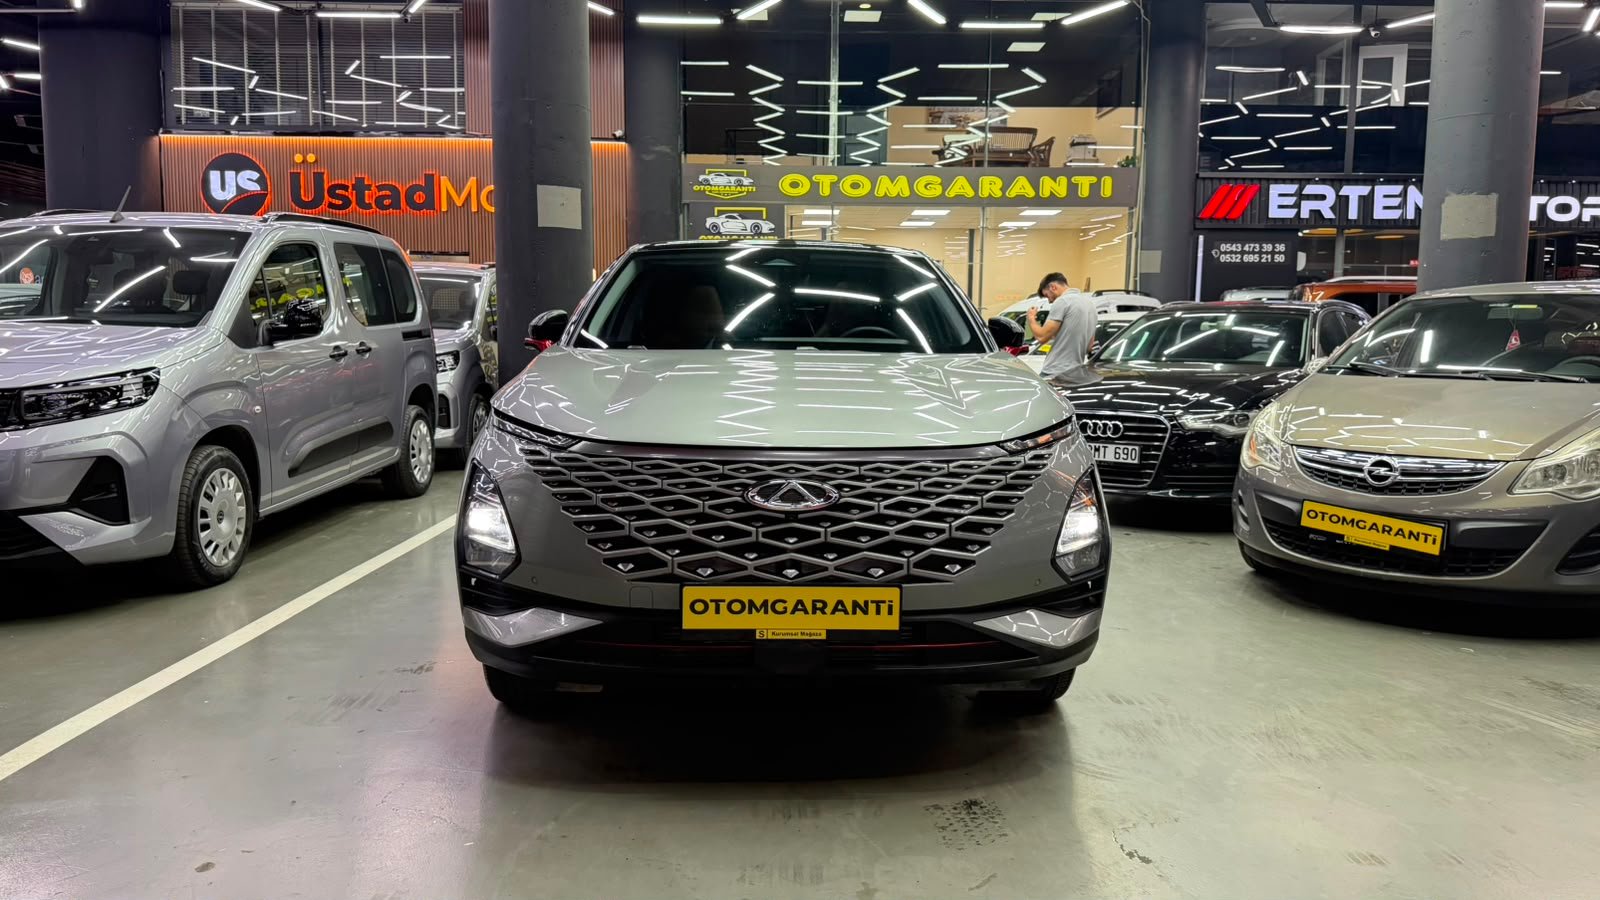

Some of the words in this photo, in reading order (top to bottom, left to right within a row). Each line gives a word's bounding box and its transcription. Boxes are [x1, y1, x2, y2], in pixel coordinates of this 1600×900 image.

[209, 170, 261, 200] US
[693, 185, 757, 193] OTOMGARANTI
[778, 172, 1112, 198] OTOMGARANTI
[1220, 243, 1242, 252] 0543
[1243, 243, 1260, 252] 473
[1261, 243, 1273, 252] 39
[1274, 243, 1286, 252] 36
[1219, 254, 1242, 262] 0532
[1243, 254, 1260, 262] 695
[1261, 254, 1272, 262] 21
[1274, 254, 1285, 262] 50
[1114, 446, 1138, 461] 690
